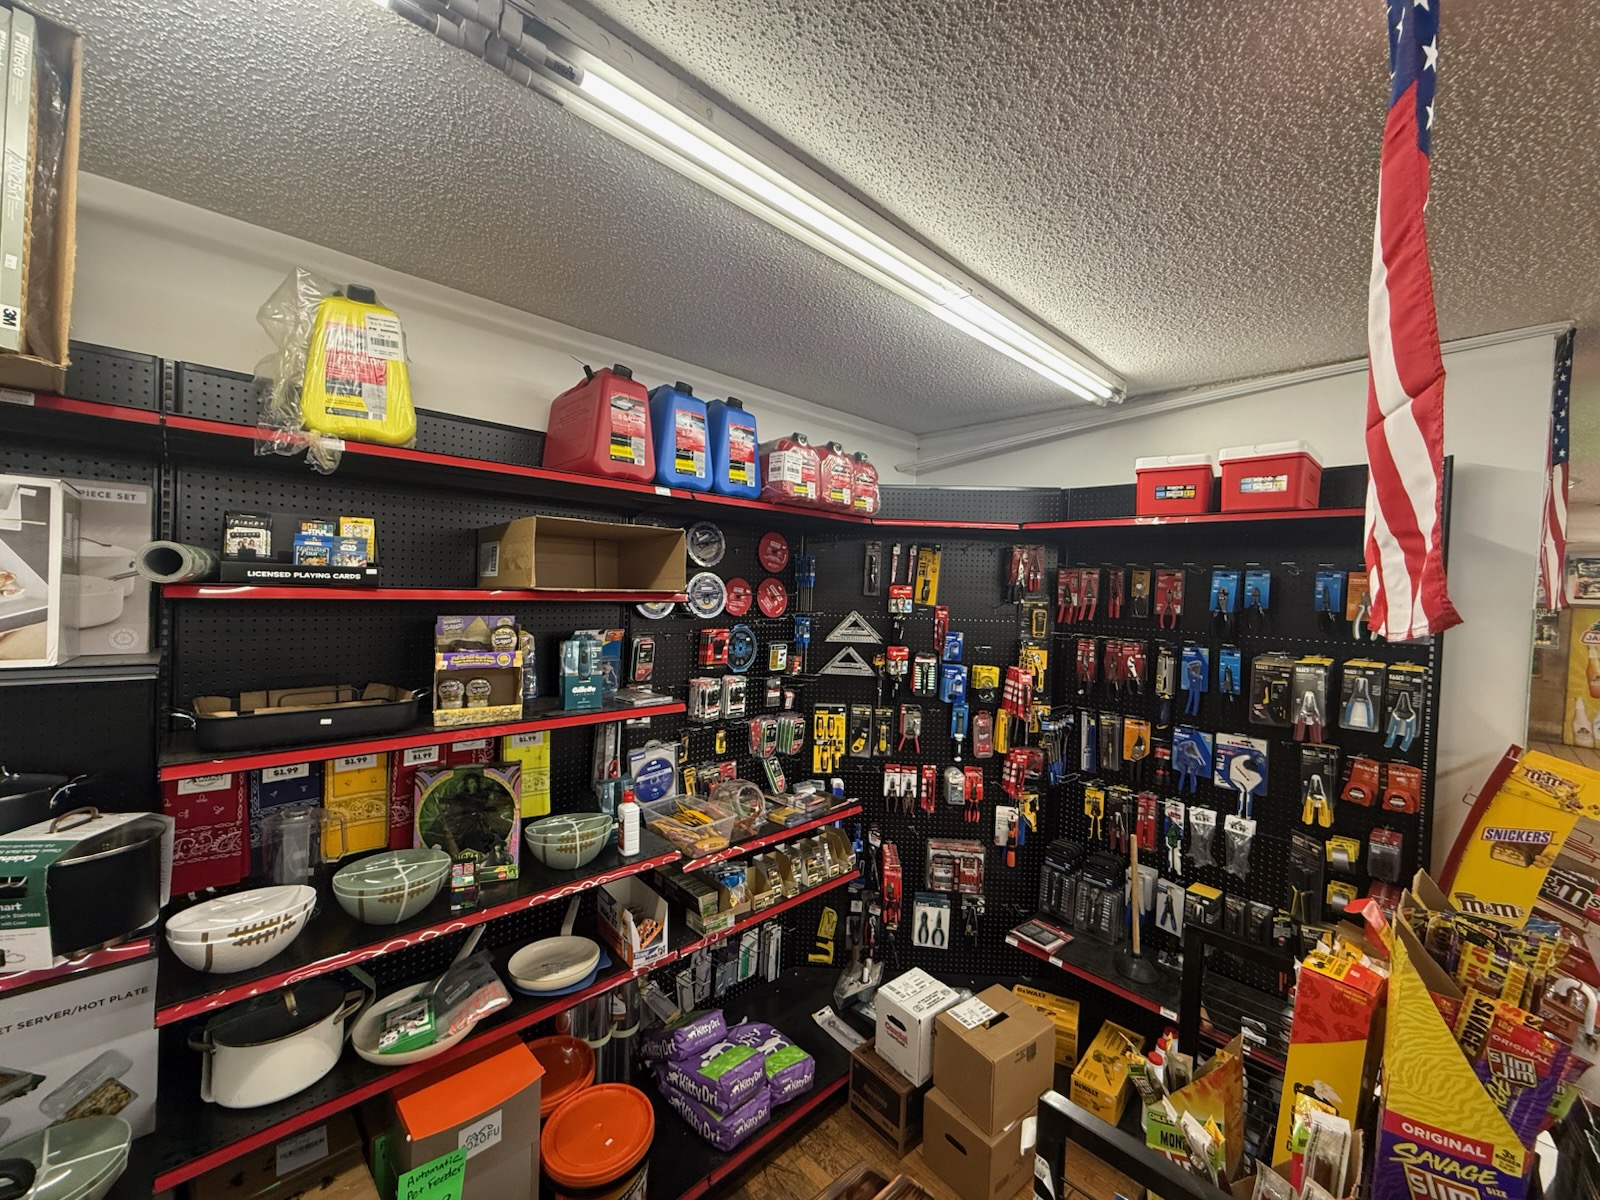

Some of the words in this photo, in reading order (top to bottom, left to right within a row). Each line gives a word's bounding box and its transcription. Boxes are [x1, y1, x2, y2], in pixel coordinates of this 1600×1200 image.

[12, 31, 30, 78] Filtrete
[2, 307, 17, 327] 3M
[78, 488, 114, 500] PIECE
[116, 492, 137, 502] SET
[247, 570, 292, 578] LICENSED
[293, 571, 332, 579] PLAYING
[332, 572, 362, 580] CARDS
[571, 685, 597, 694] Gillette
[519, 734, 537, 743] $1.99
[344, 756, 368, 765] $1.99
[412, 752, 433, 761] $1.99
[273, 766, 299, 776] $1.99
[1484, 827, 1551, 844] SNICKERS
[17, 999, 106, 1030] SERVER/HOT
[109, 985, 149, 1003] PLATE
[1491, 1034, 1550, 1066] ORIGINAL
[1400, 1121, 1487, 1159] ORIGINAL
[406, 1154, 464, 1188] Automatic
[1389, 1142, 1499, 1186] SAVAGE
[406, 1186, 425, 1200] Pet
[427, 1162, 465, 1190] Feeder
[1485, 1186, 1508, 1198] SIZE
